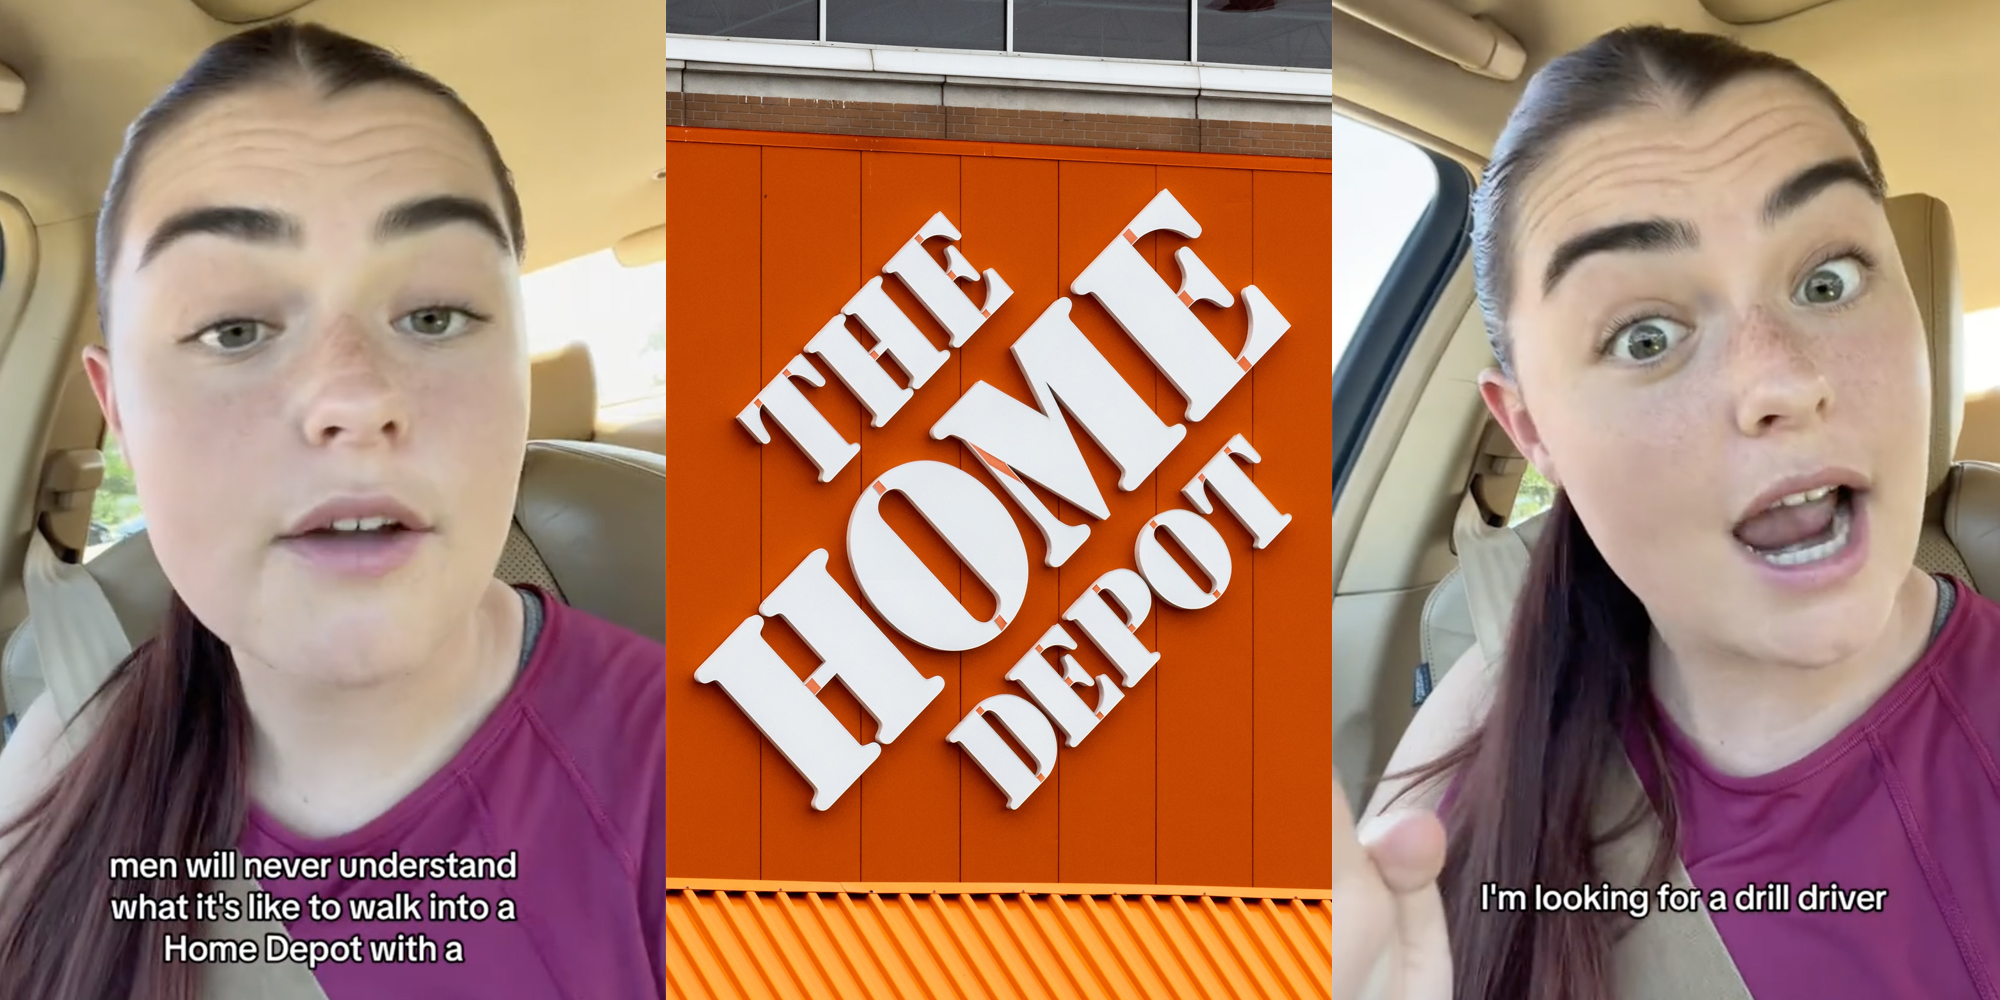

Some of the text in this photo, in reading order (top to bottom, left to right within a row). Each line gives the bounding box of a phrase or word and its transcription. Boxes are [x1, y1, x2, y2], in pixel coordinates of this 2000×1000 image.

[693, 188, 1292, 811] HOME
[735, 211, 1015, 483] THE
[946, 433, 1293, 810] DEPOT
